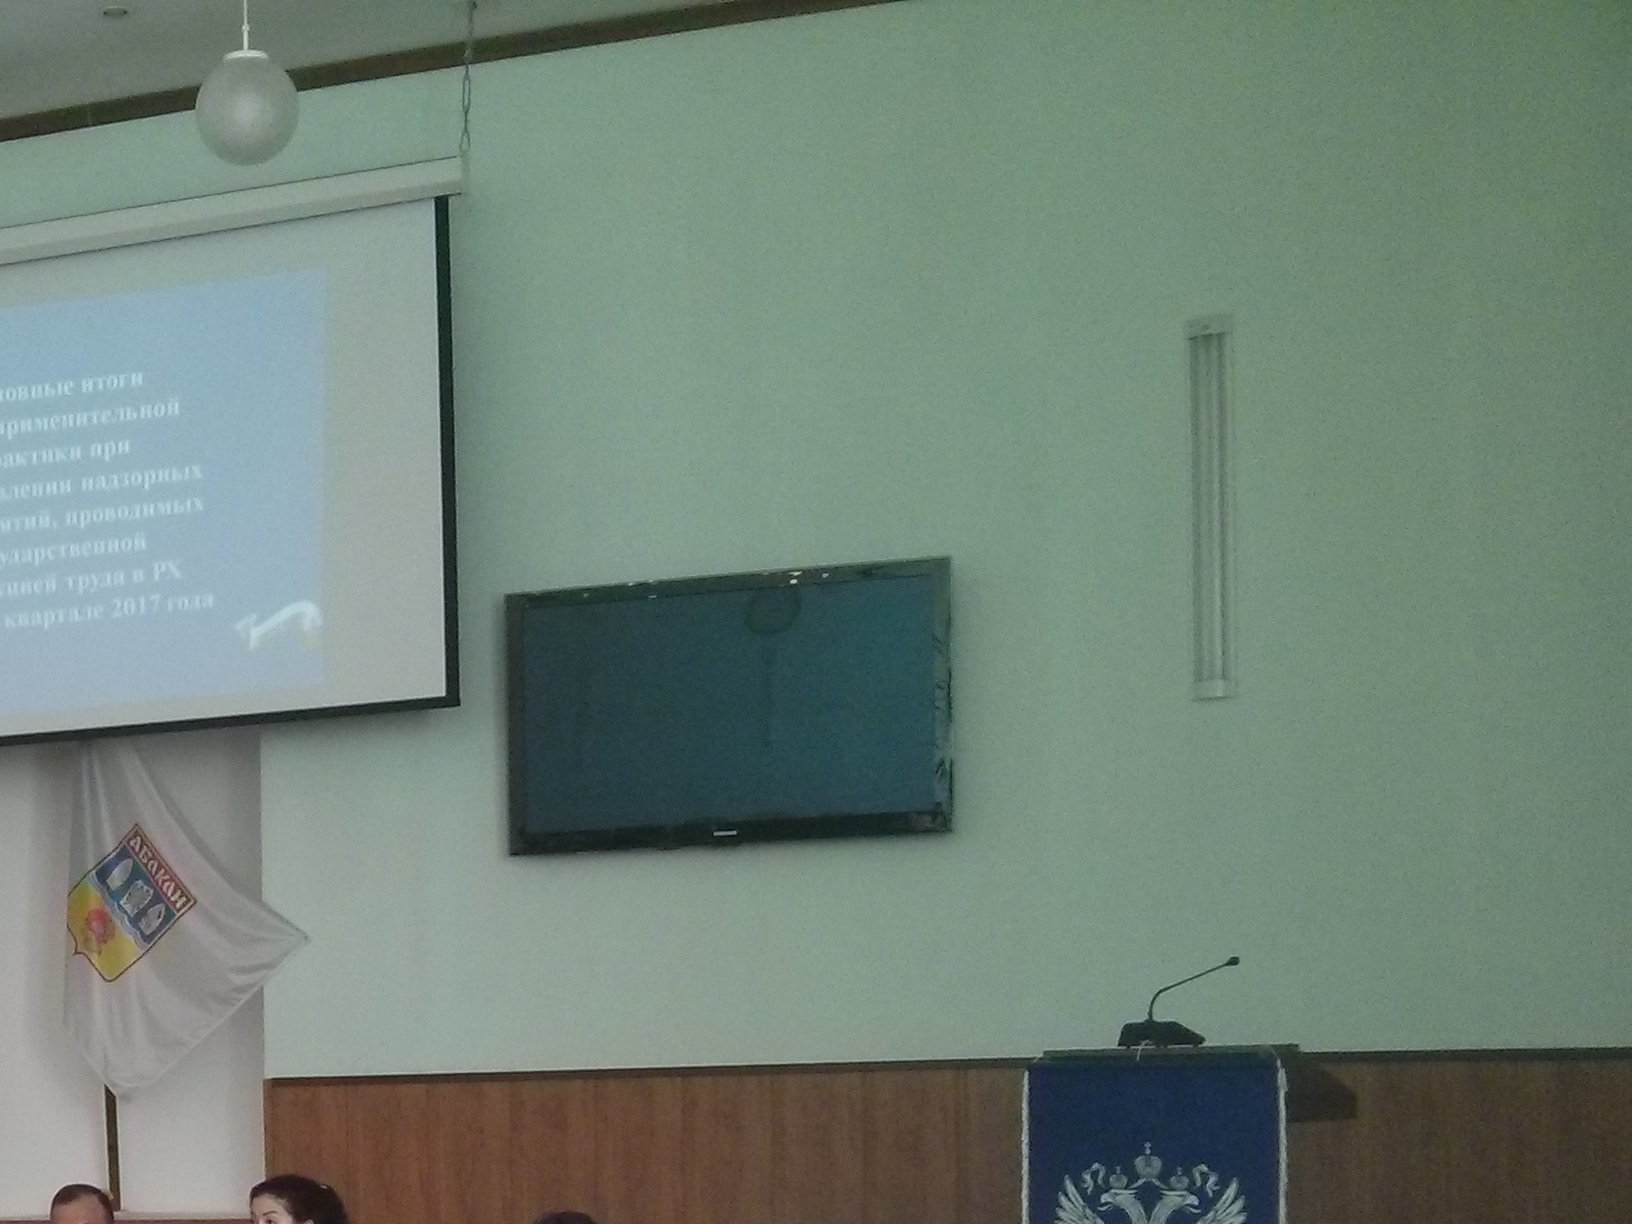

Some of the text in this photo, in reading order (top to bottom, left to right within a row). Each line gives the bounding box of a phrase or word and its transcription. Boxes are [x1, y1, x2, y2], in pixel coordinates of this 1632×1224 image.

[81, 372, 143, 394] итоги
[90, 439, 130, 462] при
[81, 464, 202, 490] надзорных
[67, 496, 203, 529] проводимых
[65, 569, 125, 595] труда
[132, 568, 144, 583] в
[153, 558, 182, 580] РХ
[4, 603, 104, 630] квартале
[111, 594, 161, 618] 2017
[168, 593, 214, 612] года
[129, 835, 189, 909] АБАКАН
